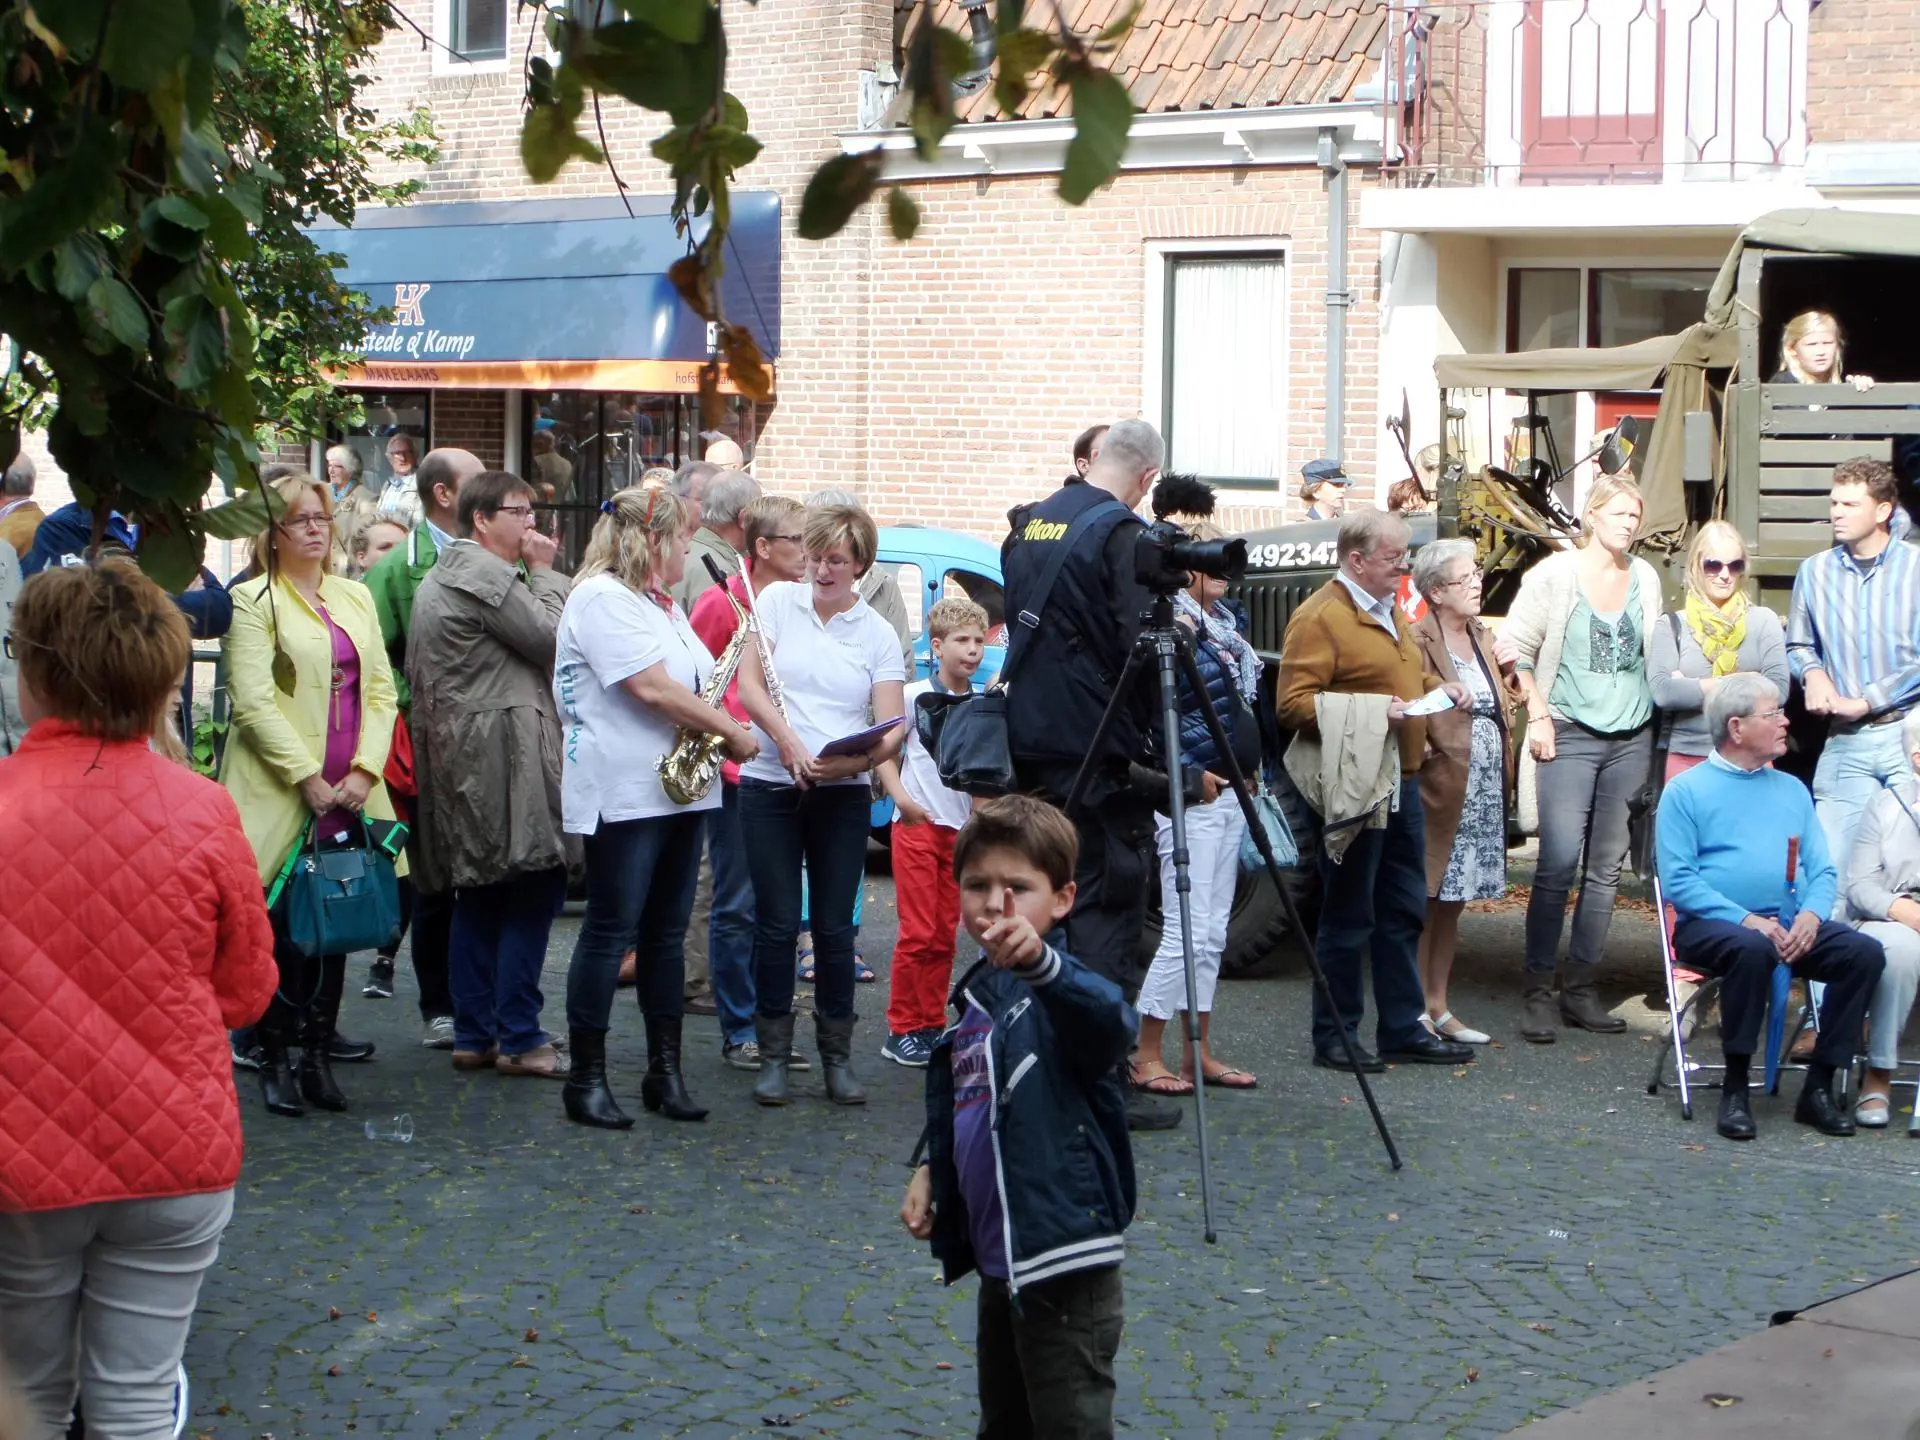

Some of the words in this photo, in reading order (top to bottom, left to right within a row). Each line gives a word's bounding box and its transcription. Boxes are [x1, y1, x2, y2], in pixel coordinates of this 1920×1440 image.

[338, 327, 405, 354] stede
[423, 329, 476, 360] Kamp
[364, 367, 439, 382] MAKELAARS
[1247, 541, 1338, 567] 492347
